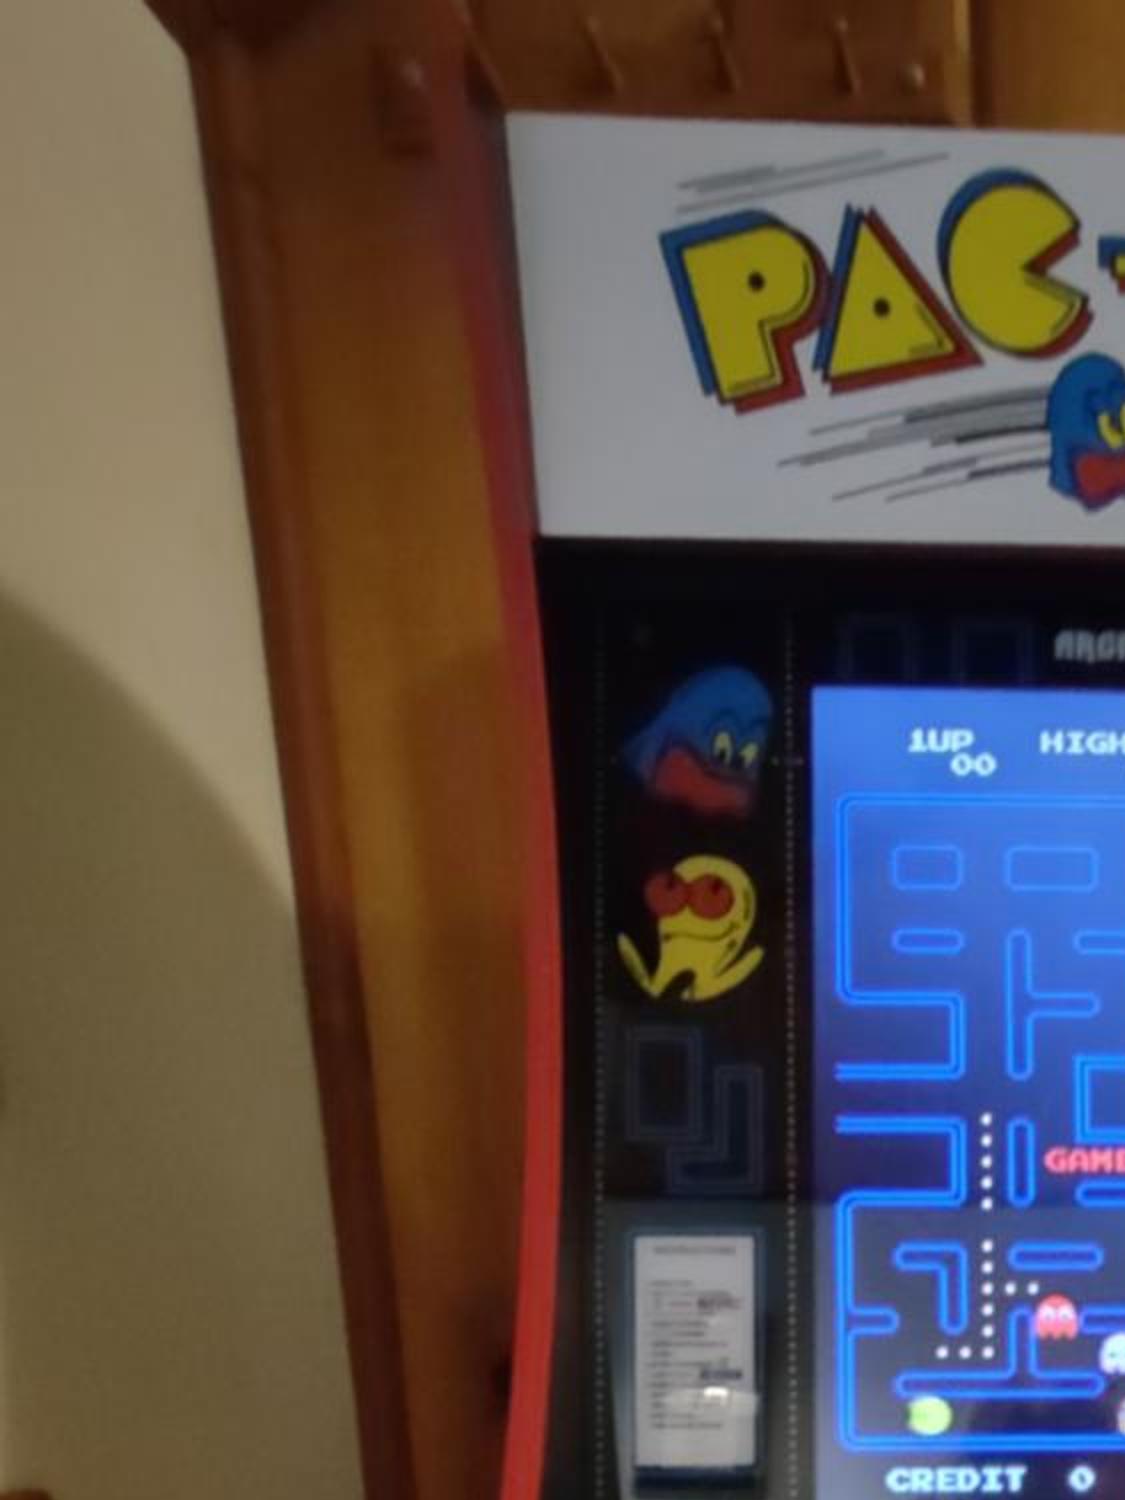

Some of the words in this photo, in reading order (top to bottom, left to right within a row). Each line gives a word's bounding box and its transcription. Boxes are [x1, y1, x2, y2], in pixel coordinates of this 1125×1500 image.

[908, 728, 975, 753] 1UP
[950, 754, 996, 777] 00
[886, 1466, 1026, 1494] CREDIT
[1069, 1466, 1096, 1493] 0
